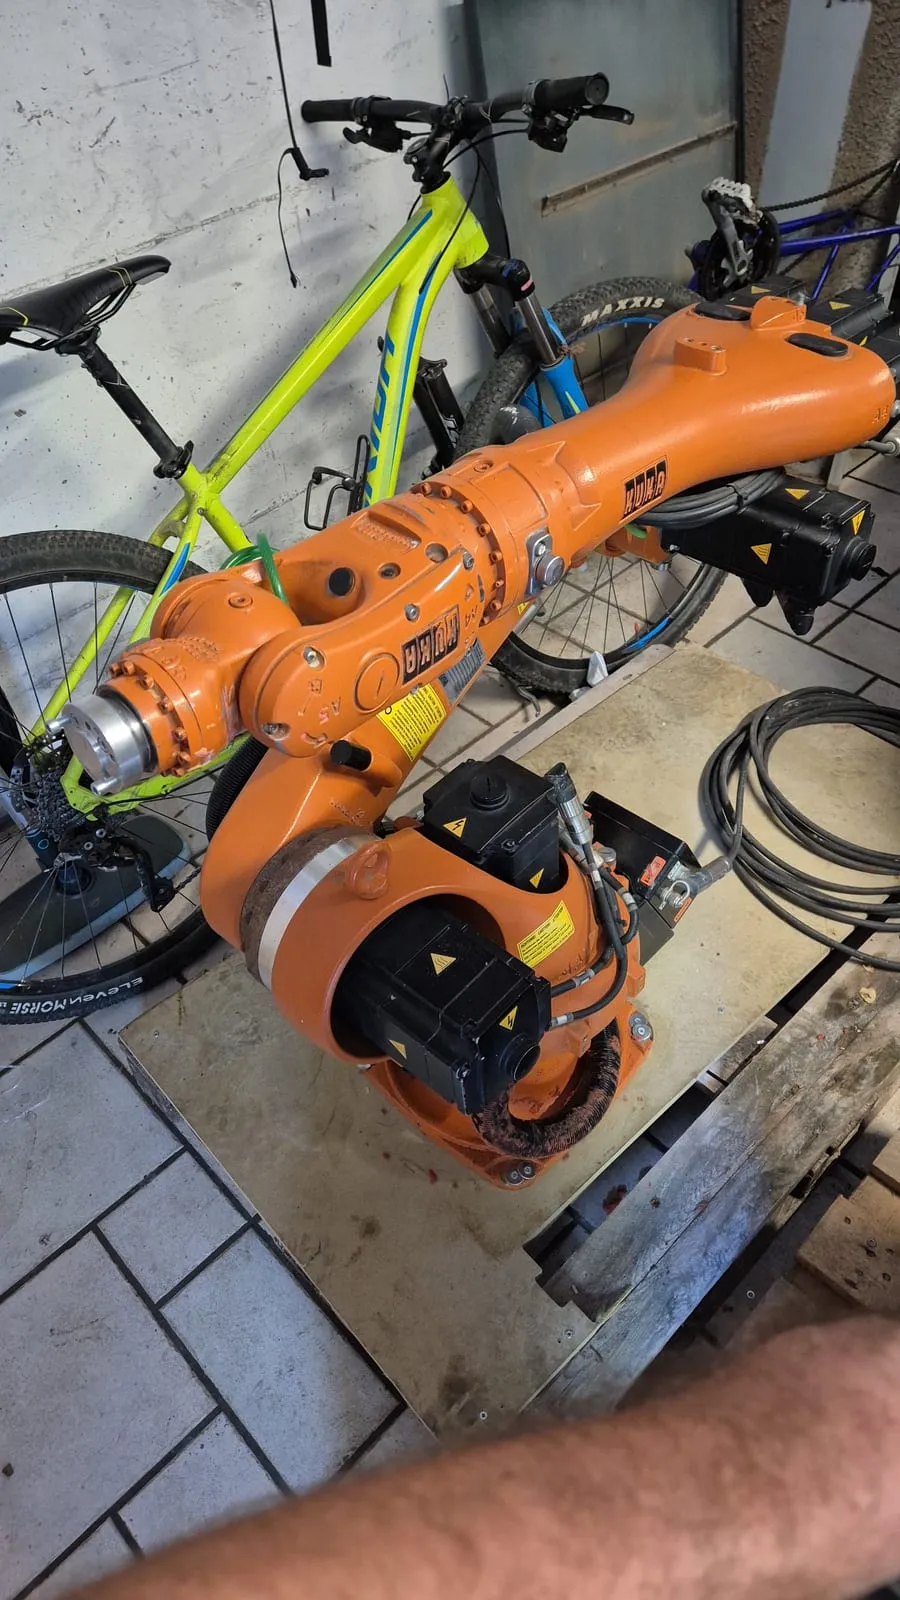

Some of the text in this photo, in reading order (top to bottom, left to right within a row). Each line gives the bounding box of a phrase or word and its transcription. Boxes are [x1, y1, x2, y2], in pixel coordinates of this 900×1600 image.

[581, 296, 665, 327] MAXXIS
[623, 466, 666, 515] KUKA
[404, 611, 458, 676] KUKA
